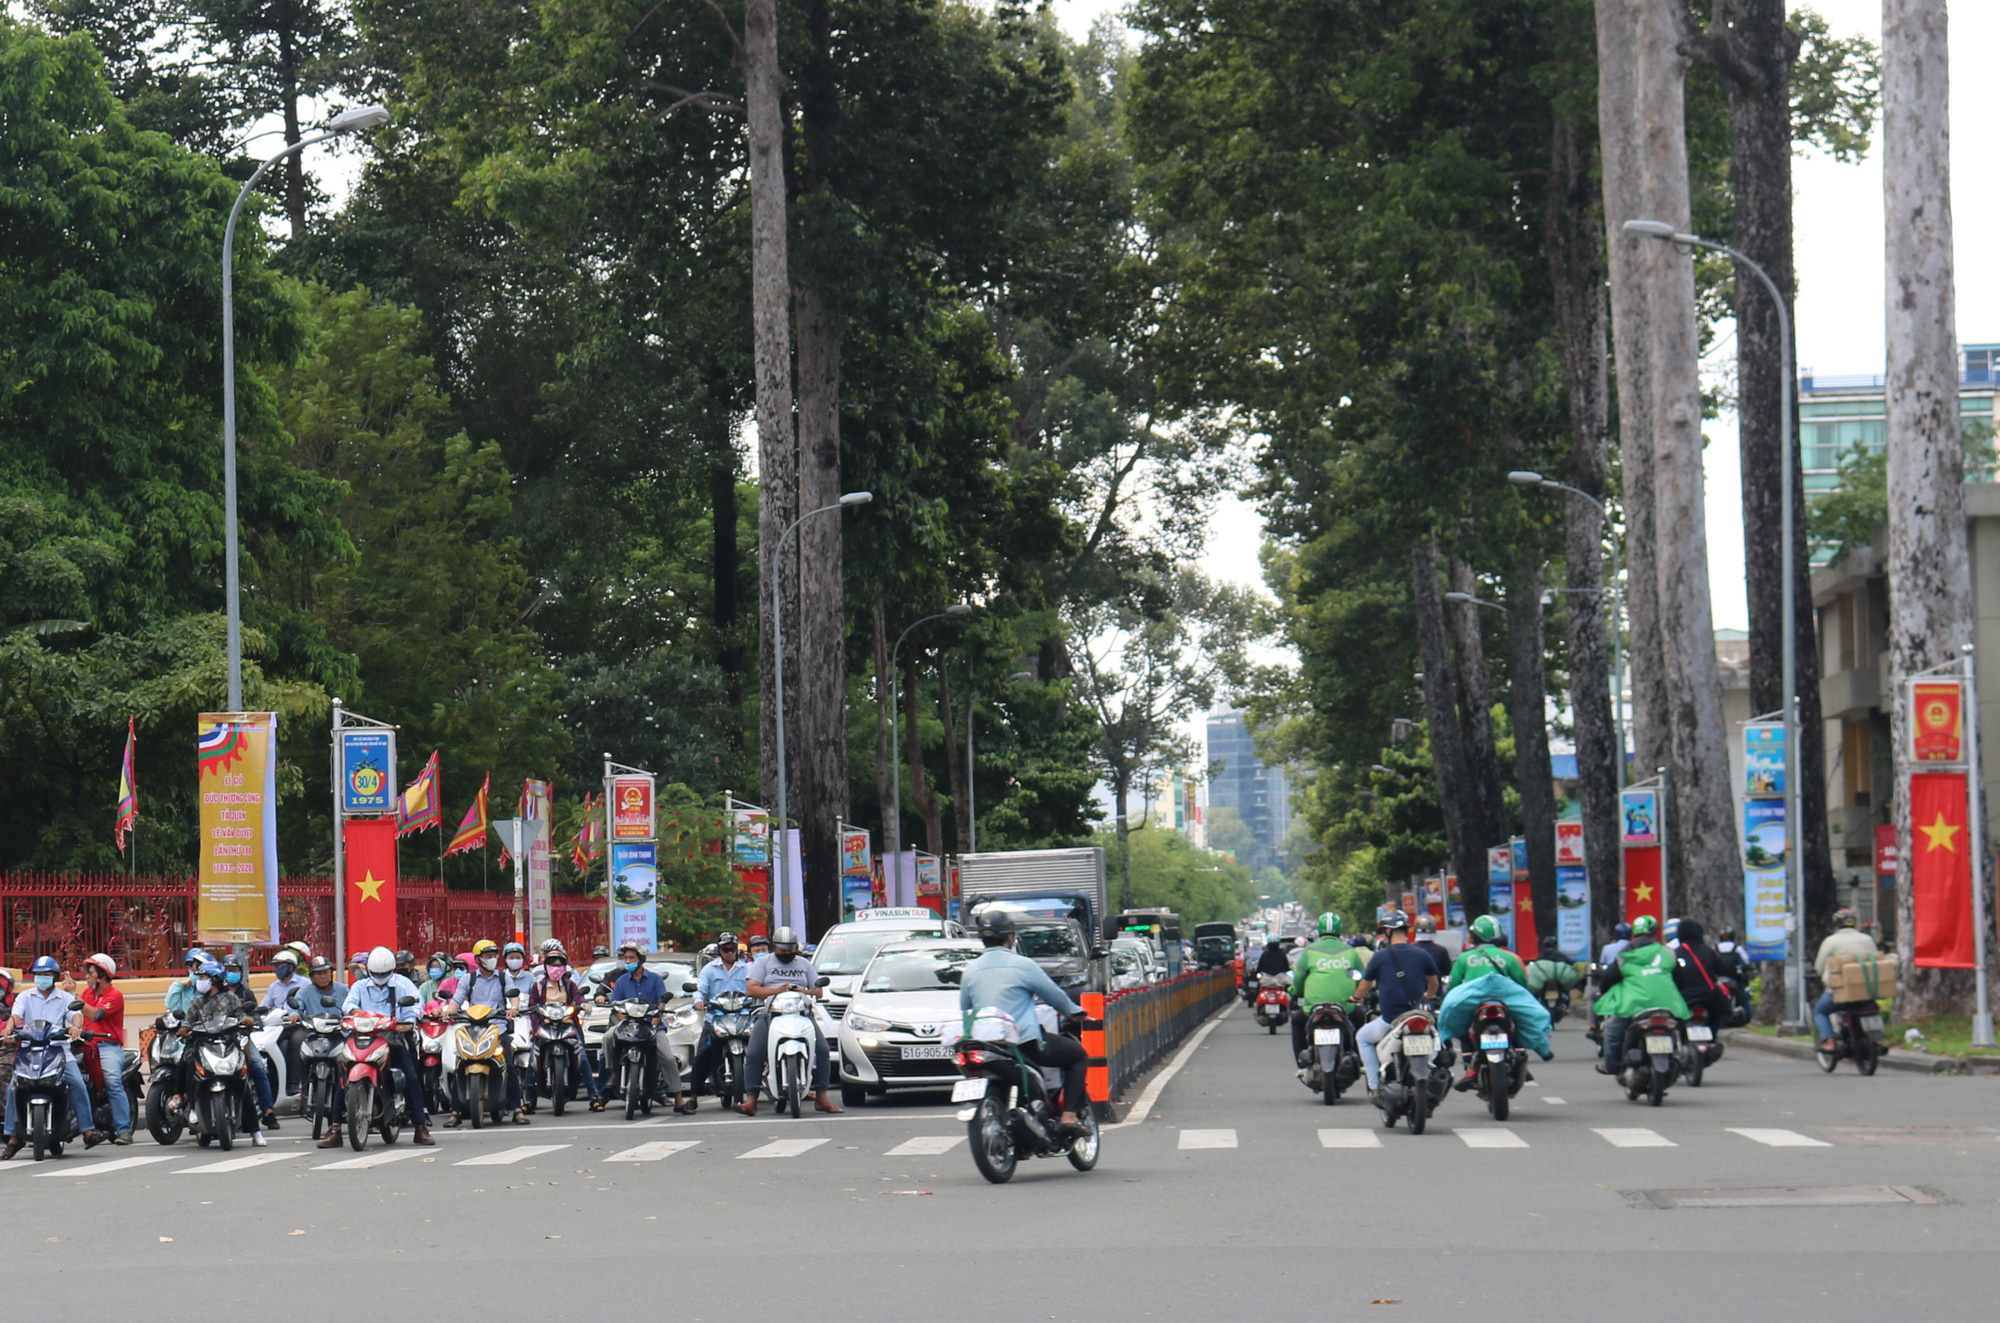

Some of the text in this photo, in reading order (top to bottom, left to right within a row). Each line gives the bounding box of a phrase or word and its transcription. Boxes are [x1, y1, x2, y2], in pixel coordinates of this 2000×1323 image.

[356, 776, 378, 788] 30/4
[352, 796, 384, 804] 1975
[874, 909, 928, 918] VINASUN TAXI
[1316, 956, 1351, 970] Grab
[1466, 954, 1506, 968] Grab
[771, 968, 804, 977] ARMY
[903, 1048, 955, 1058] 51G-905.26
